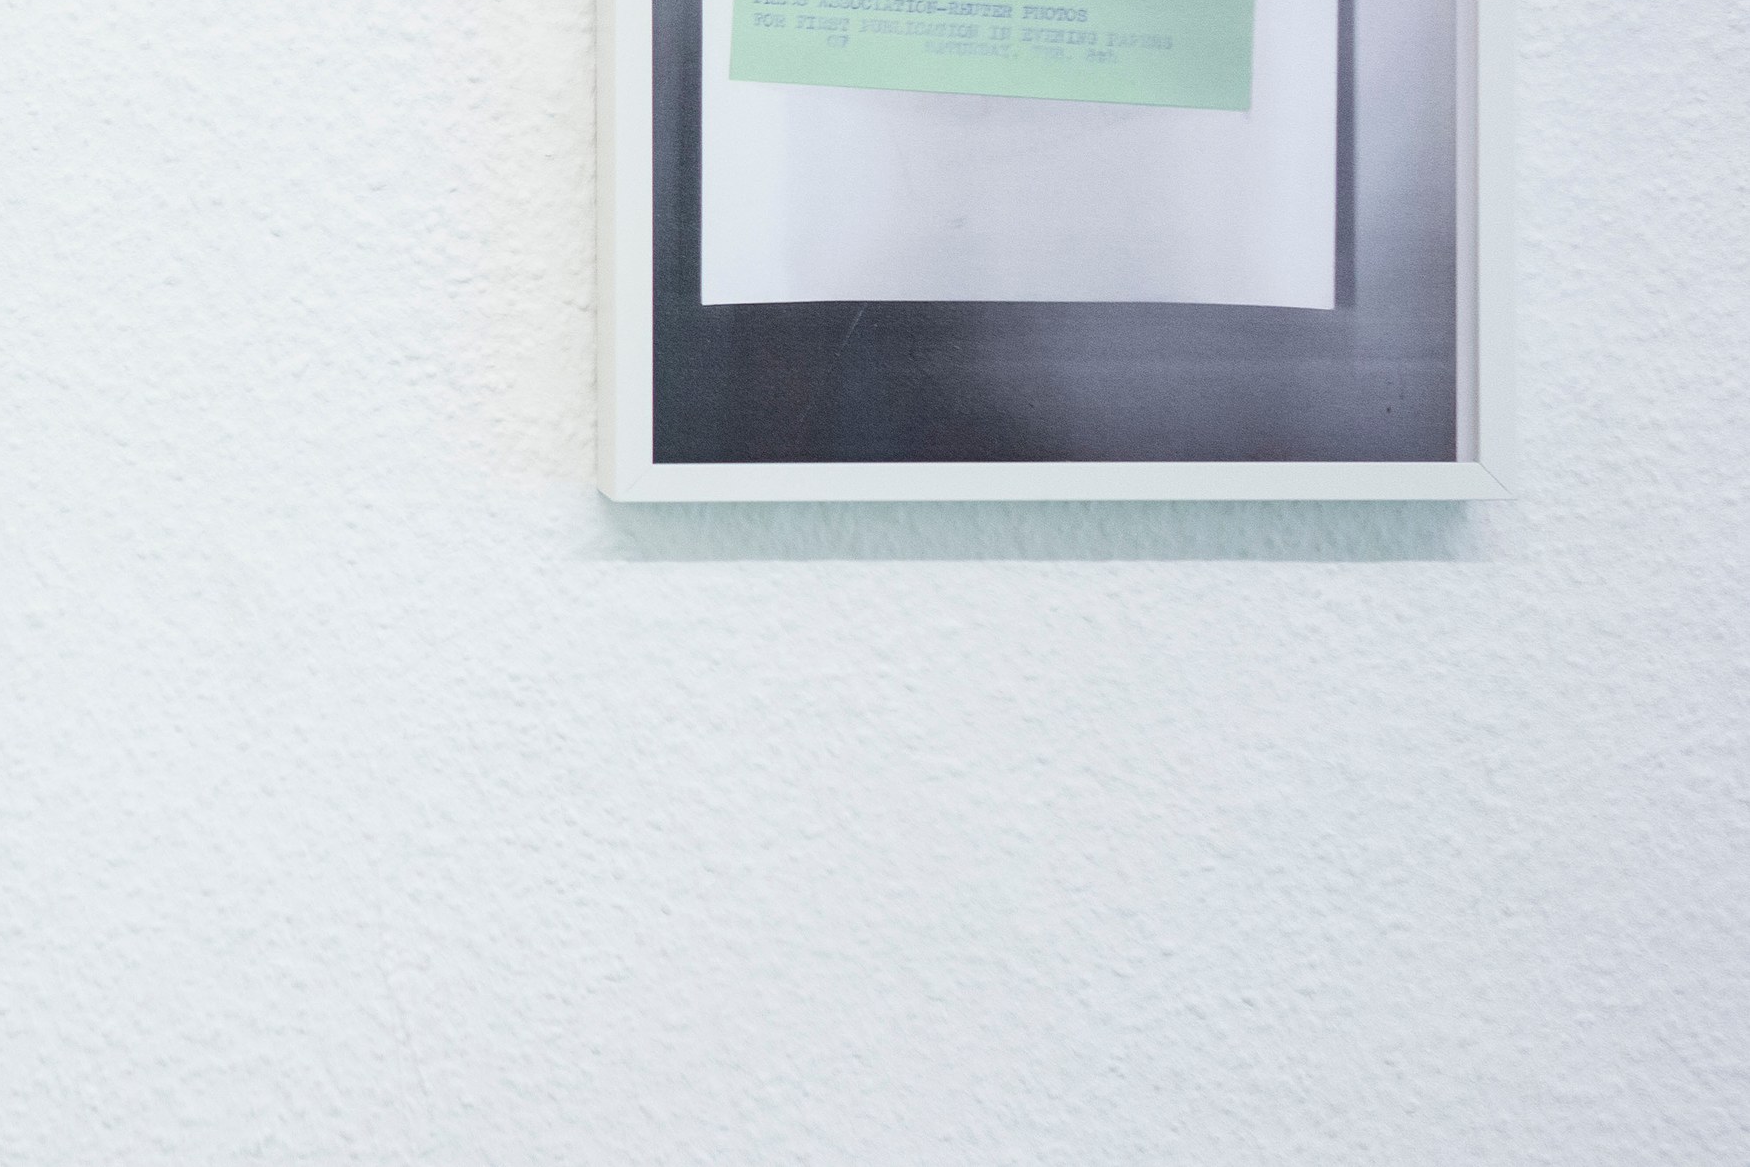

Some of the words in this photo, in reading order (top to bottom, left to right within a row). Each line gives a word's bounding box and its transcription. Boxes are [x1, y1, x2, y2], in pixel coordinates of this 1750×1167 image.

[1022, 5, 1088, 22] PHOTOS
[753, 12, 786, 28] FOR
[989, 25, 1012, 40] IN
